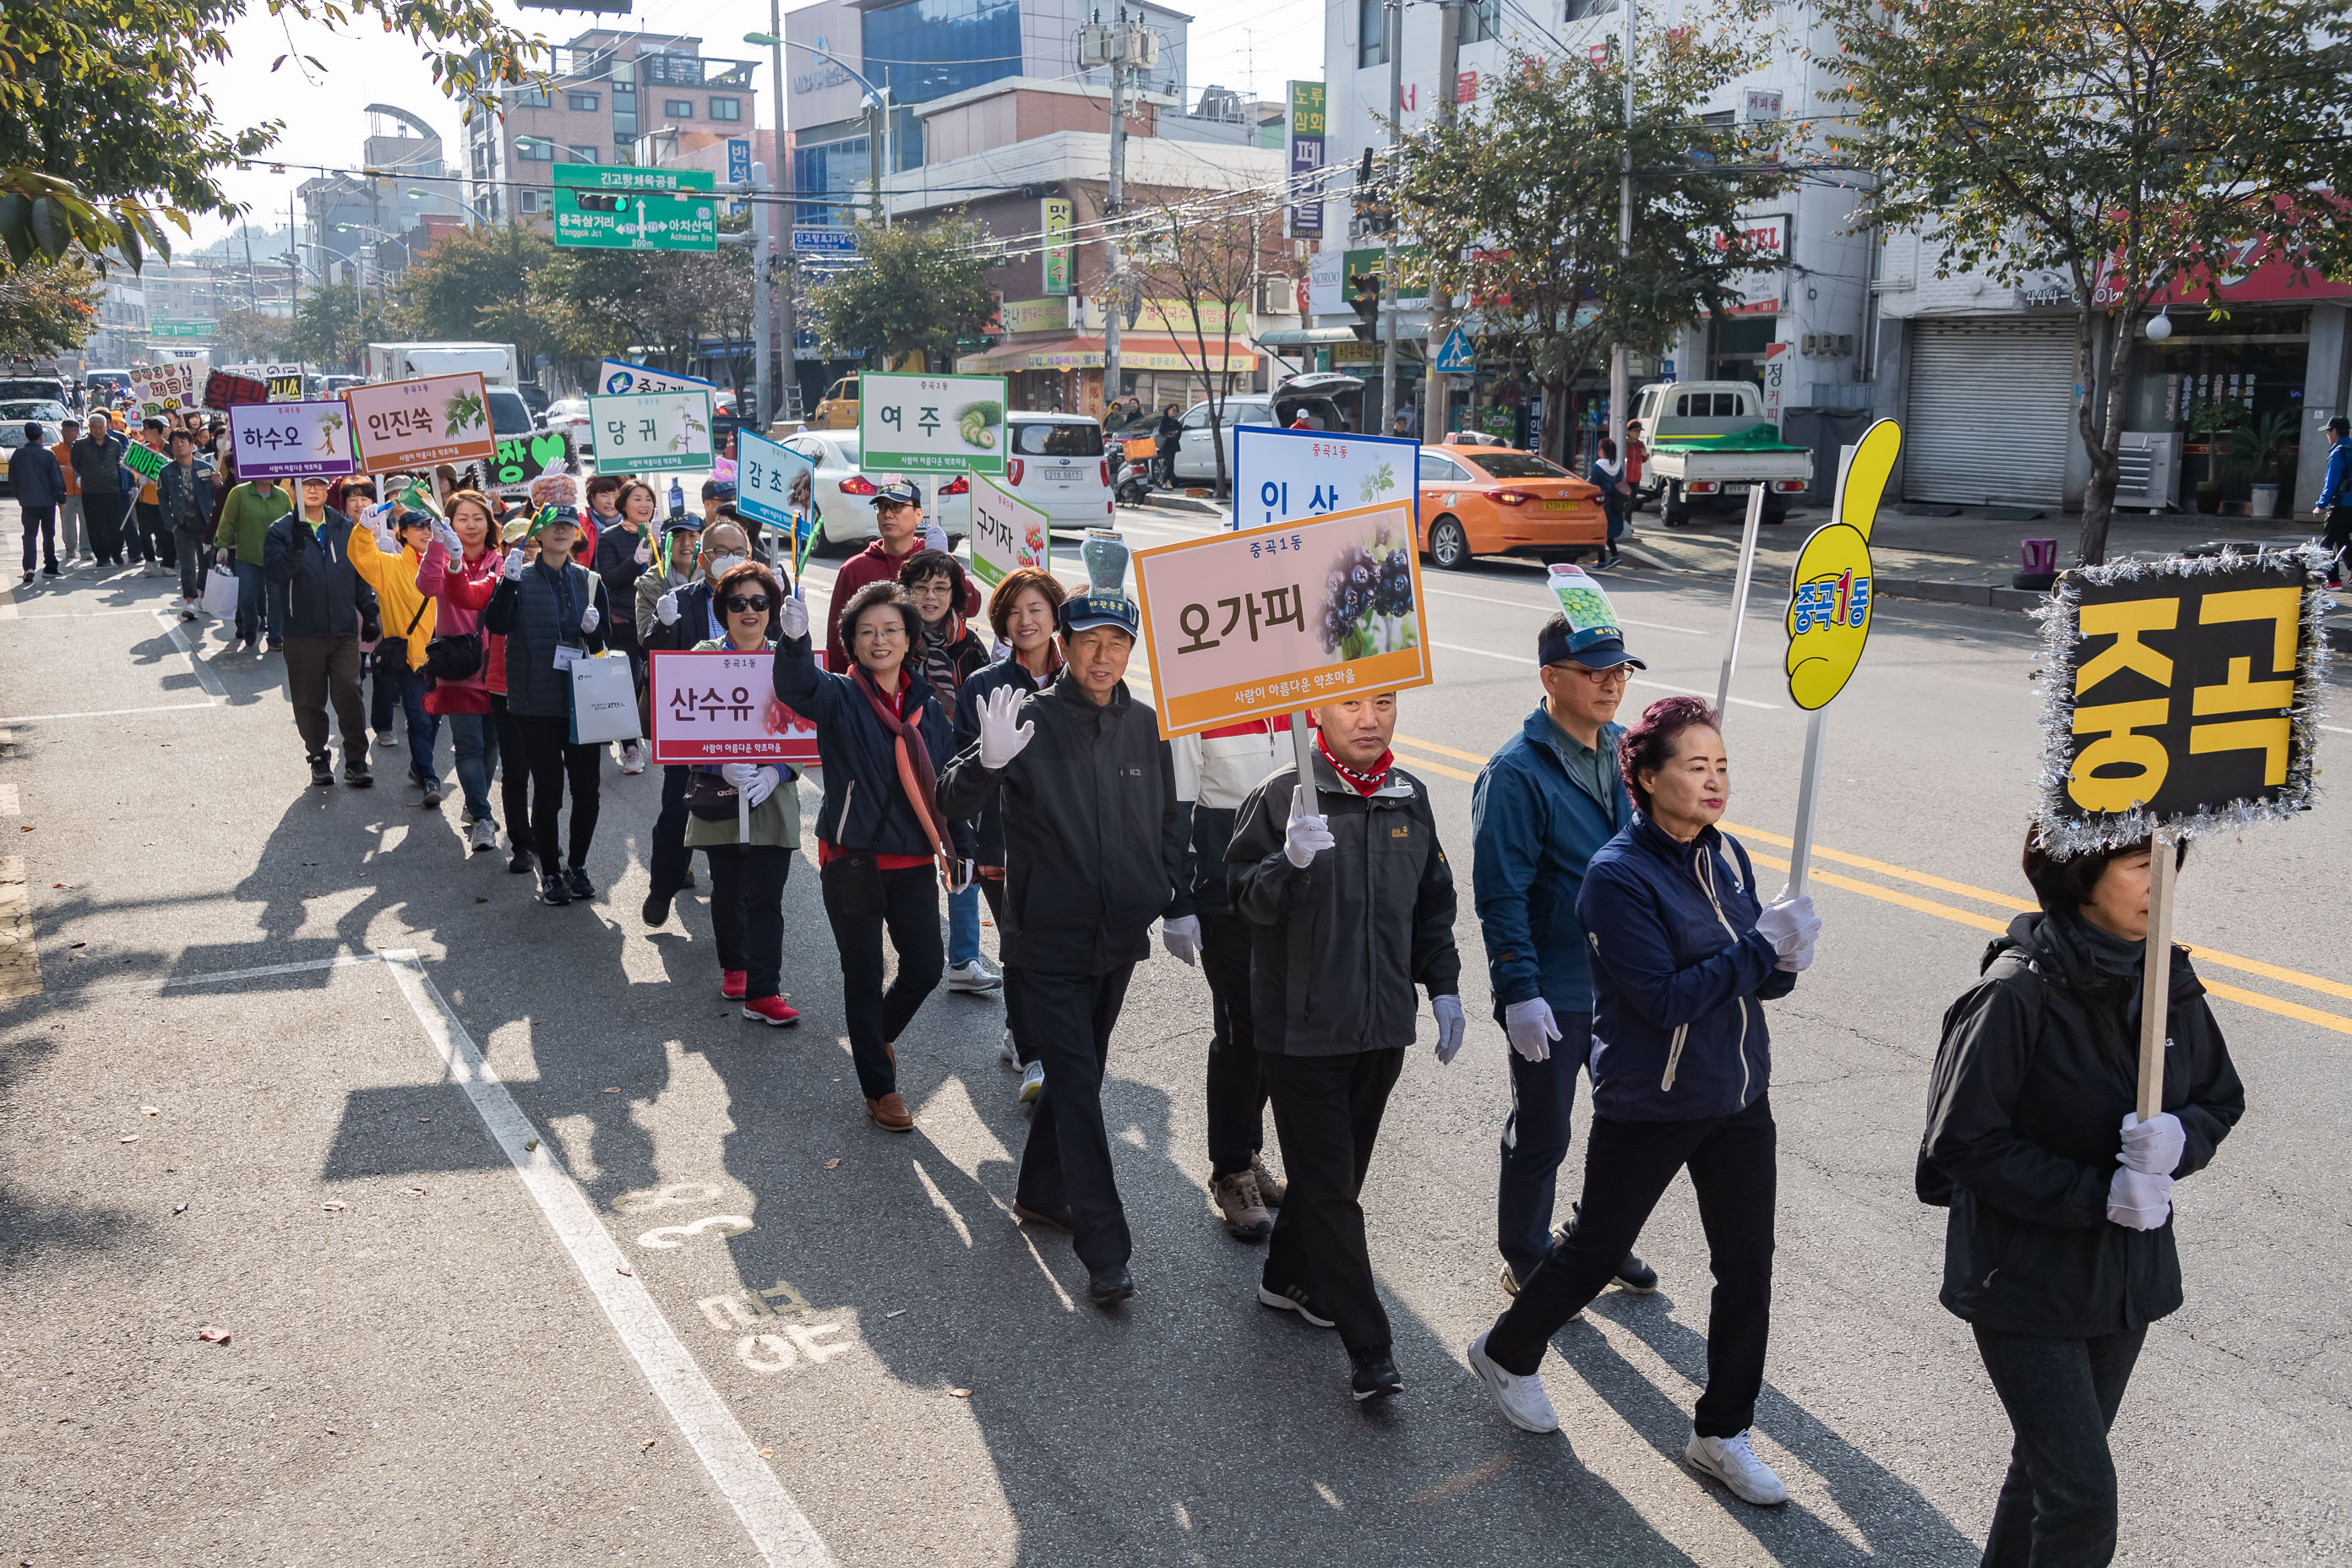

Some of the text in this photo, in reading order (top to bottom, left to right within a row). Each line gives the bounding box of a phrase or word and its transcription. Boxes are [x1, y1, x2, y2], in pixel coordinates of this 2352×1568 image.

[1293, 86, 1324, 106] 노루
[1749, 96, 1780, 113] 커피숍
[1293, 112, 1324, 133] 삼화
[601, 172, 677, 188] 긴고랑체육공원
[558, 214, 614, 228] 용곡삼거리
[669, 220, 712, 233] 아차산역
[559, 228, 602, 238] Yonggok Jct
[670, 232, 712, 242] Achasan Stn
[632, 240, 653, 248] 200m
[1311, 272, 1340, 286] NOROO
[920, 381, 949, 390] 중곡1동
[1767, 362, 1783, 423] 정 커피
[368, 407, 433, 441] 인진쑥
[242, 426, 302, 451] 하수오
[1312, 443, 1348, 460] 중곡1동
[901, 456, 918, 465] 사람이
[919, 457, 943, 466] 아름다운
[977, 507, 1013, 554] 구기자
[1250, 534, 1303, 559] 중곡1동
[1794, 567, 1870, 635] 중곡1동
[1177, 583, 1305, 655] 오가피
[723, 658, 756, 669] 중곡1동
[1233, 668, 1356, 705] 사람이 아름다운 약초마을
[669, 686, 754, 722] 산수유
[2067, 586, 2303, 814] 중곡
[702, 743, 781, 754] 사람이 아름다운 약초마을
[2164, 1037, 2175, 1047] 2
